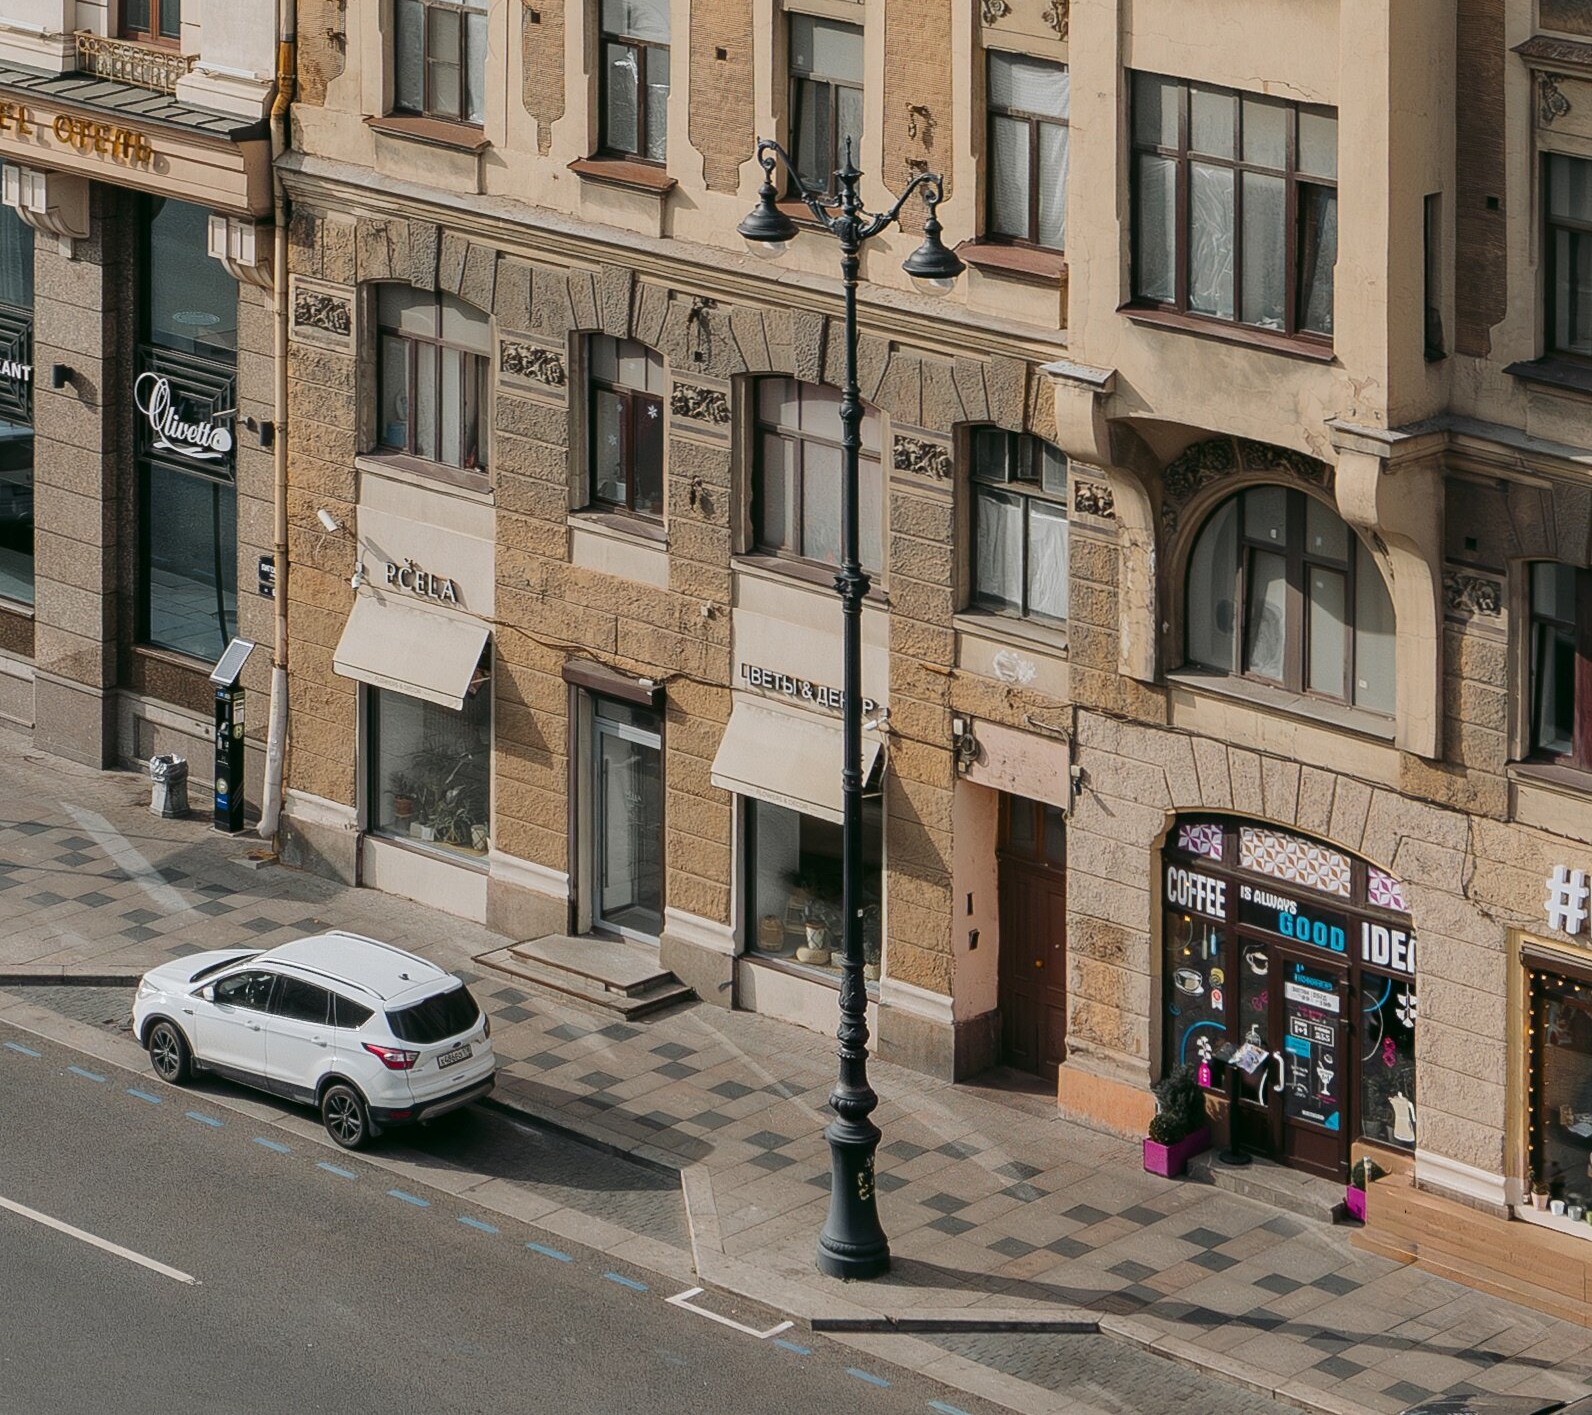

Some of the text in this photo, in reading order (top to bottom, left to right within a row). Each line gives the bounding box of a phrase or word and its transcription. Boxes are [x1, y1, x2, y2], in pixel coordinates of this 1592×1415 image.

[52, 113, 153, 163] ОТЕЛЬ
[134, 371, 233, 454] Olivetto
[384, 558, 459, 604] PČELA
[740, 663, 875, 715] ЦВЕТЫ & ДЕР
[1166, 866, 1226, 919] COFFEE
[1240, 885, 1252, 901] IS
[1253, 889, 1298, 916] ALWAYS
[1277, 911, 1345, 952] GOOD
